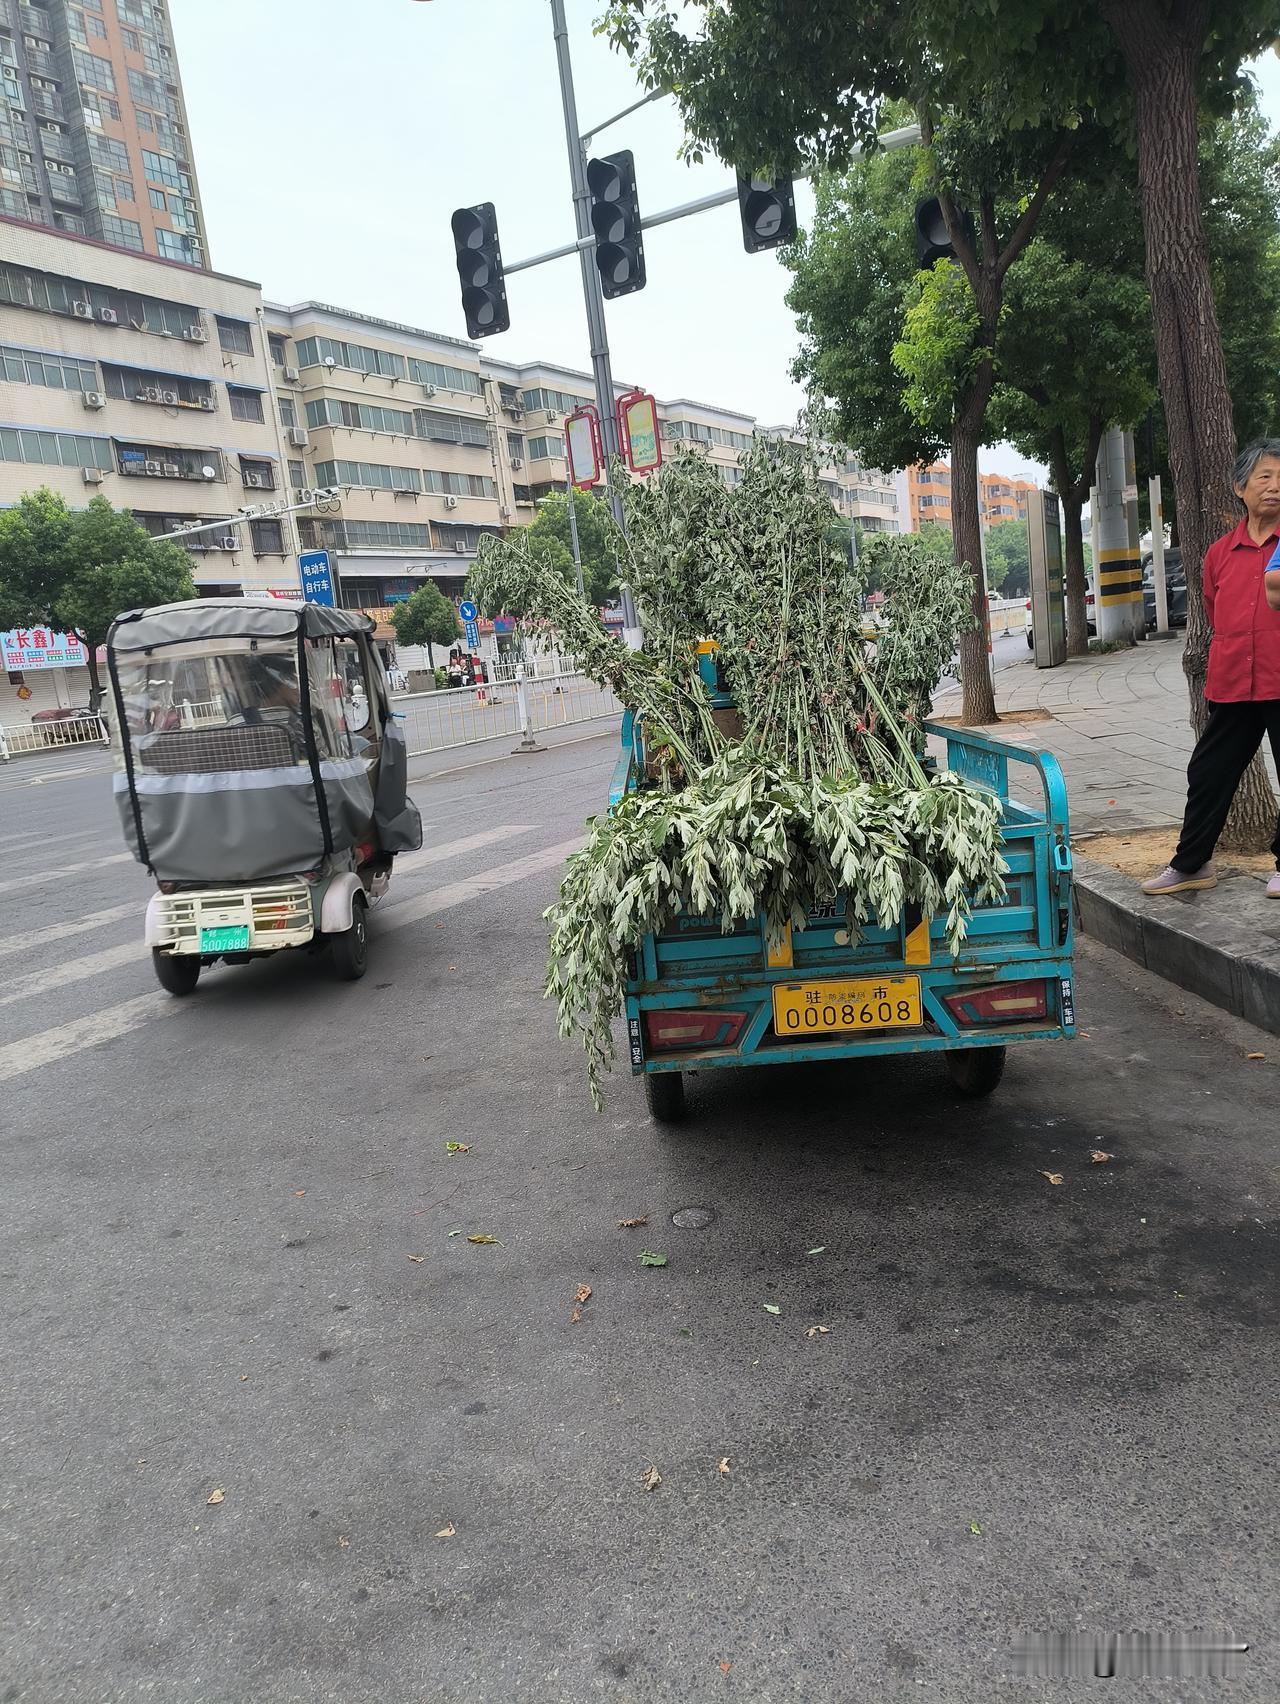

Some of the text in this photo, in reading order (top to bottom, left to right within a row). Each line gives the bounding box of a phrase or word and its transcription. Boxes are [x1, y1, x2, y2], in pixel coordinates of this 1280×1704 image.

[303, 562, 327, 576] 电动车
[305, 580, 330, 594] 自行车
[202, 938, 247, 952] 5007888
[805, 990, 822, 1004] 驻
[873, 986, 888, 1000] 市
[786, 1000, 910, 1028] 0008608
